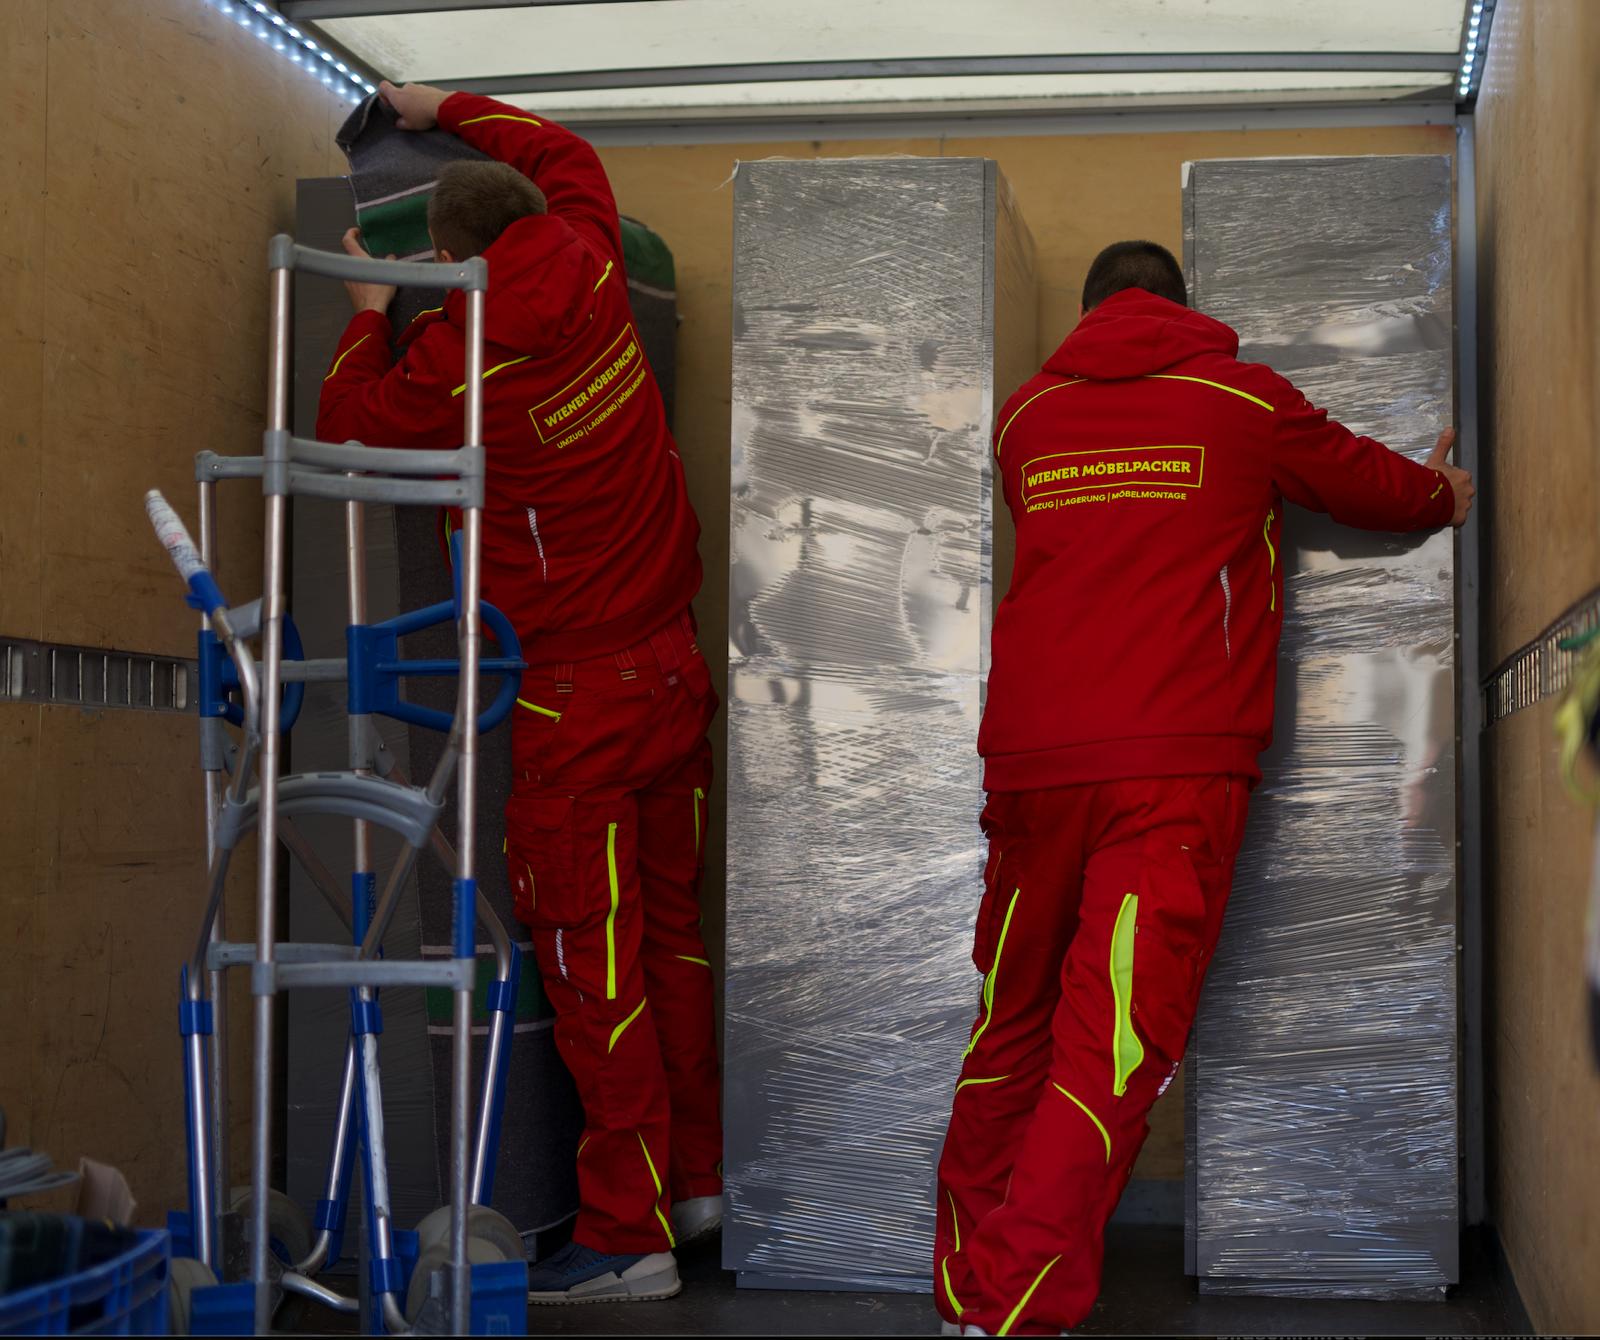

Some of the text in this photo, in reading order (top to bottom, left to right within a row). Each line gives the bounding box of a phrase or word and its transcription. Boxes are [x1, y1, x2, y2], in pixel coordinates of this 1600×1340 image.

[544, 341, 637, 427] WIENER MÖBELPACKER
[556, 429, 584, 449] UMZUG
[587, 402, 618, 431] LAGERUNG
[1027, 460, 1191, 487] WIENER MÖBELPACKER
[1027, 490, 1187, 513] UMZUG LAGERUNG MÖBELMONTAGE
